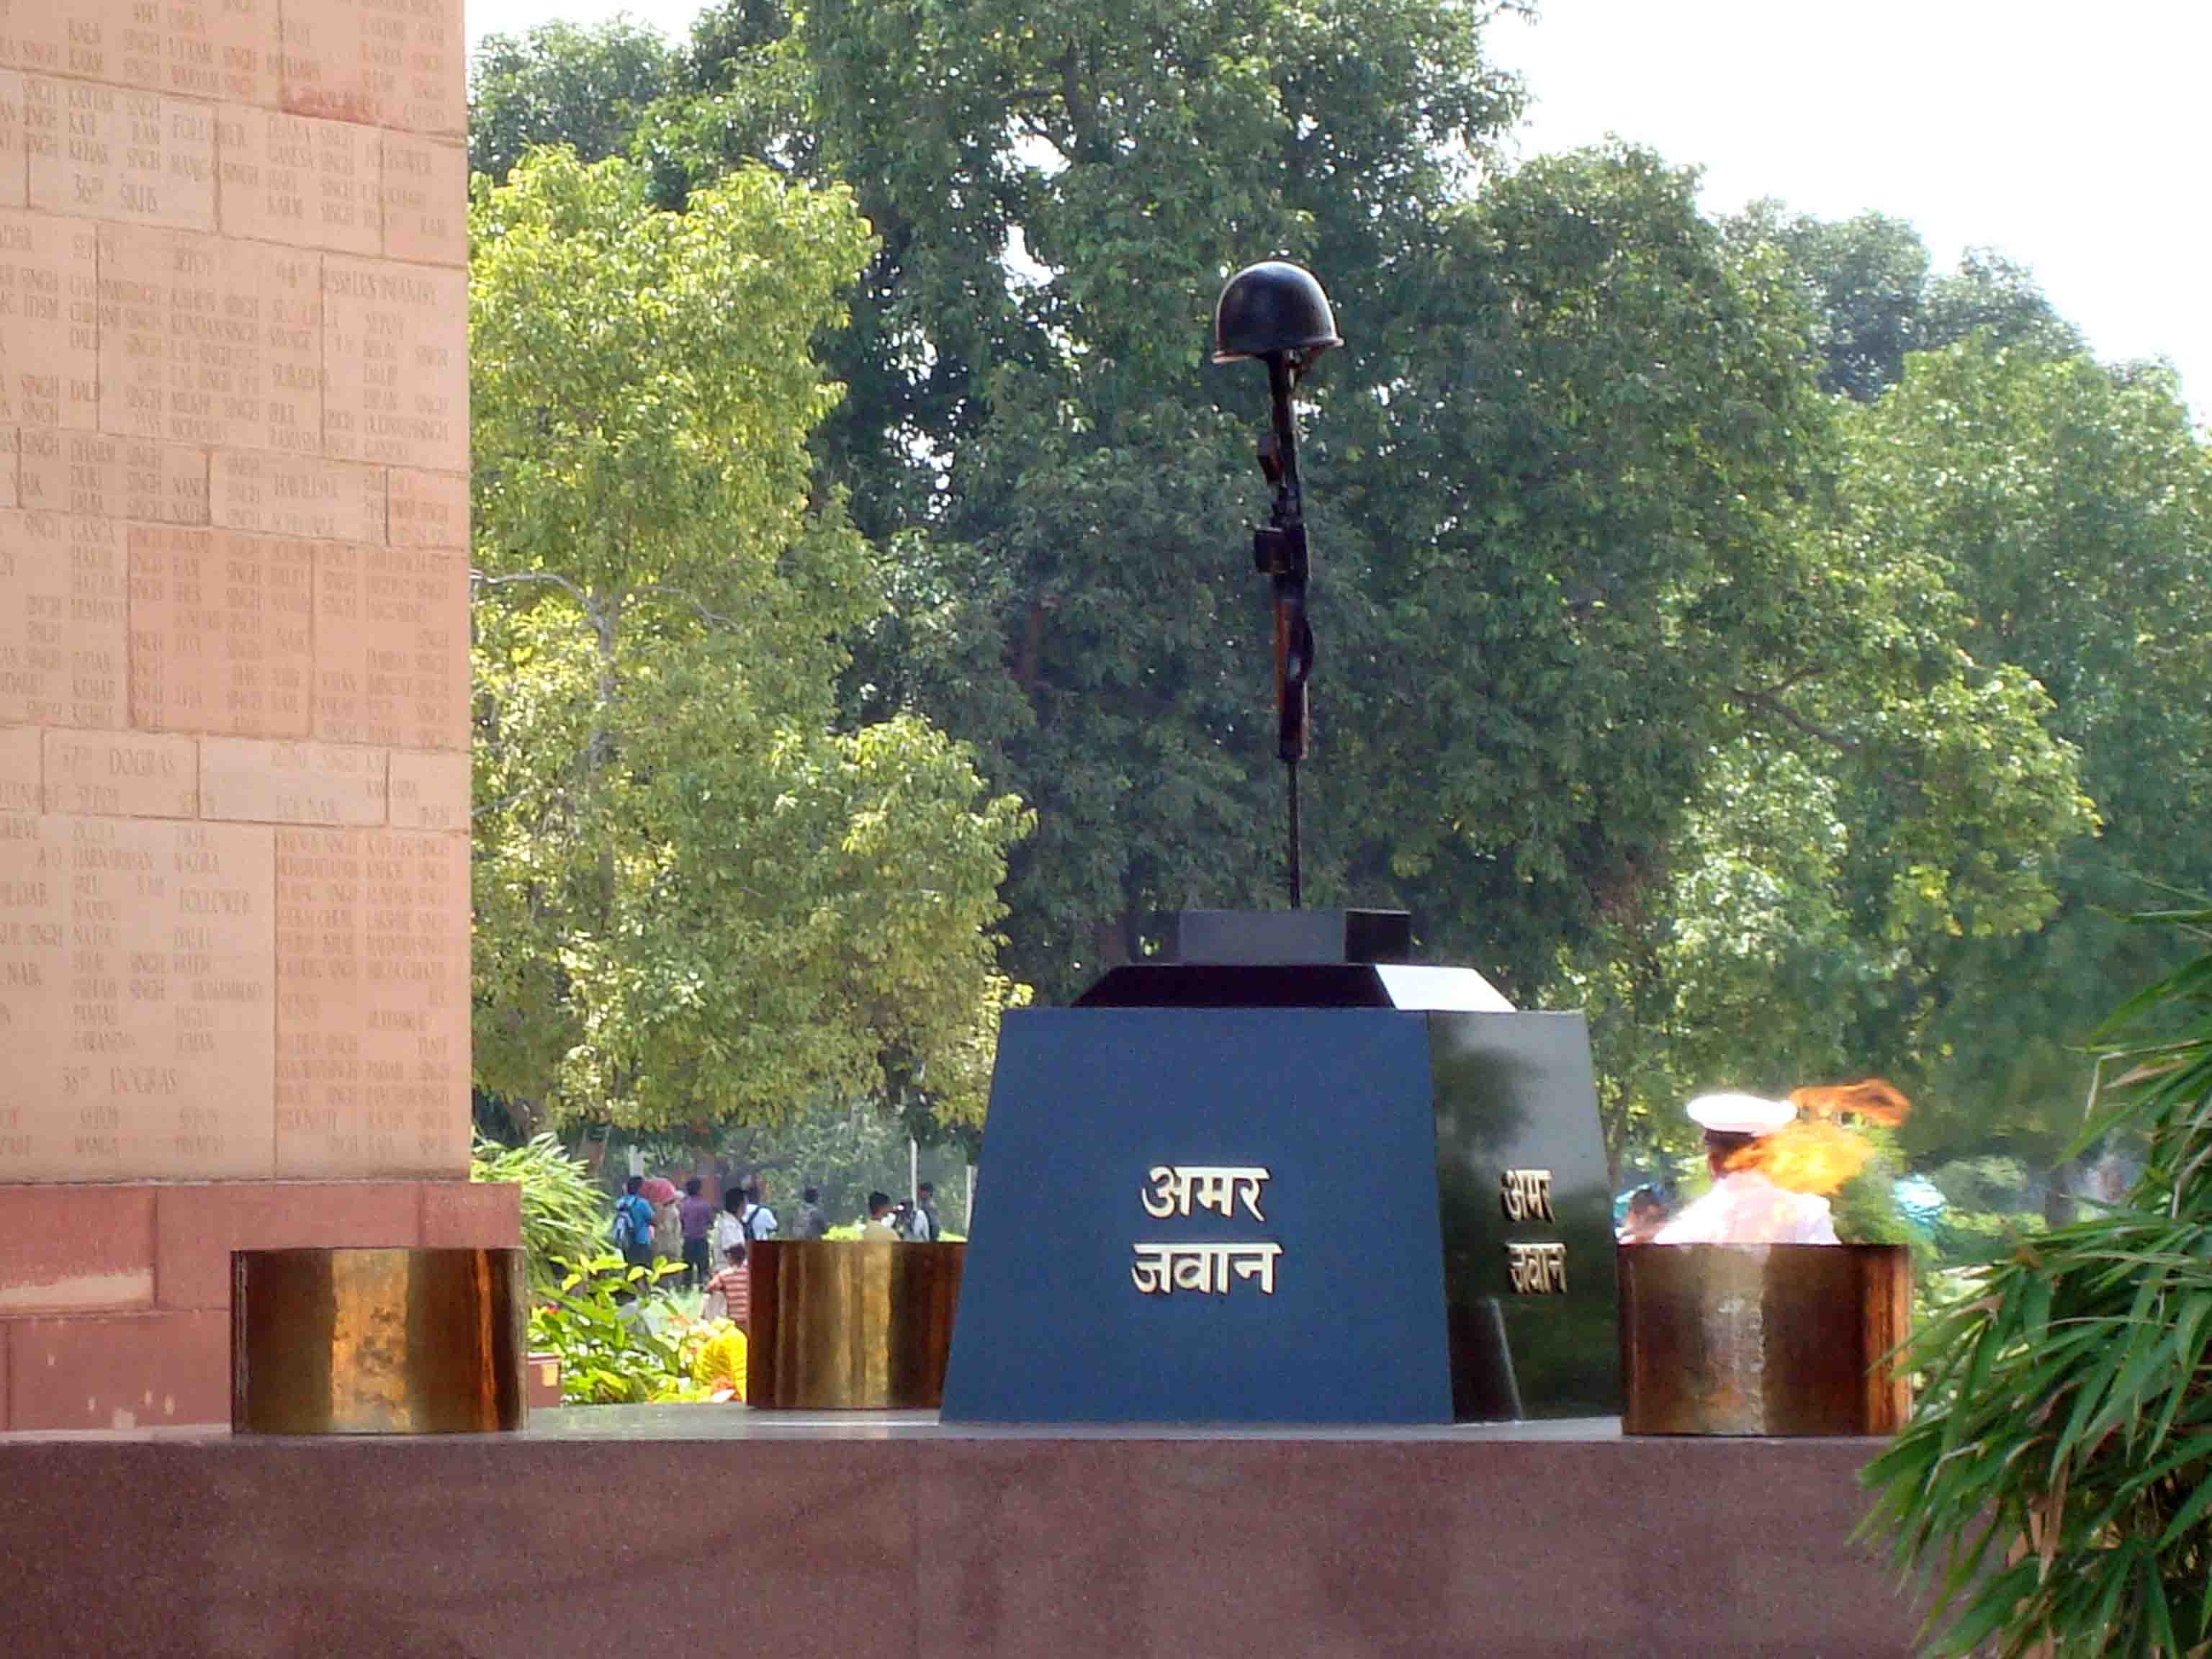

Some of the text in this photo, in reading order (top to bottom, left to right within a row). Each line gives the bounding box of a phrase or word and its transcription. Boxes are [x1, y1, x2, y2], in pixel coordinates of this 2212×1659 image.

[1141, 1166, 1270, 1222] अमर
[1504, 1169, 1555, 1223] अमर
[1130, 1243, 1284, 1294] जवान
[1506, 1243, 1565, 1293] जवान
